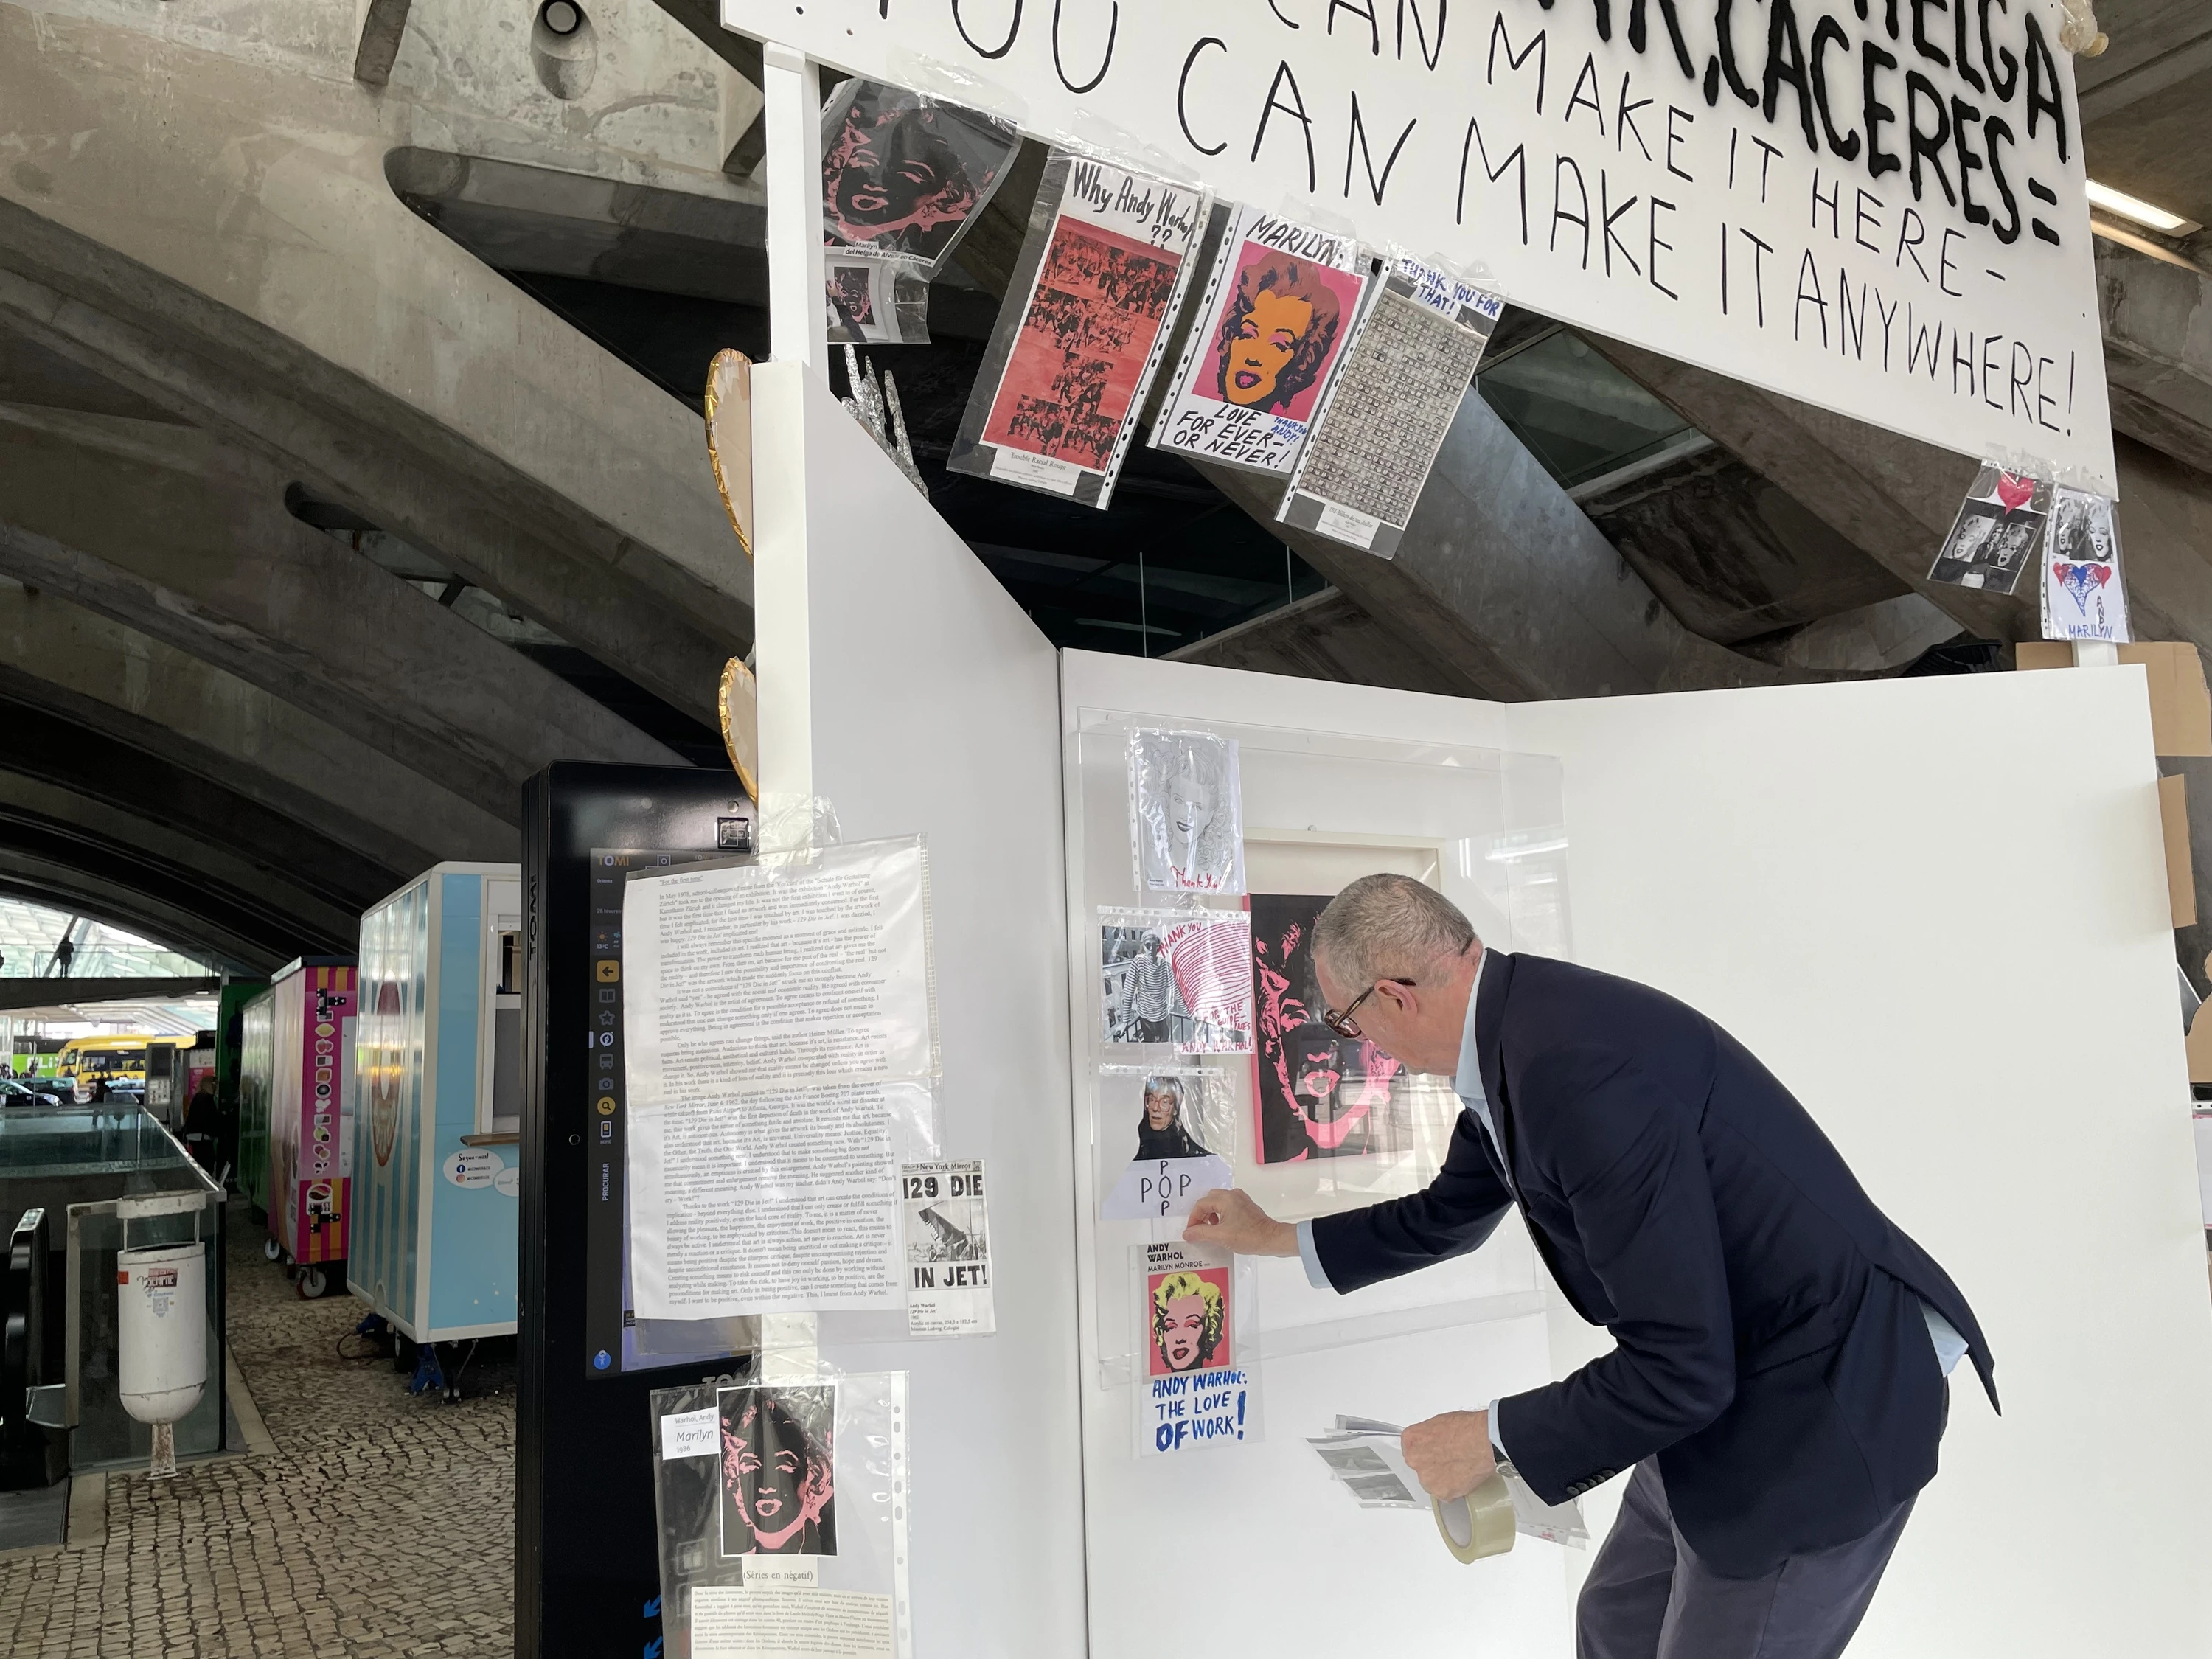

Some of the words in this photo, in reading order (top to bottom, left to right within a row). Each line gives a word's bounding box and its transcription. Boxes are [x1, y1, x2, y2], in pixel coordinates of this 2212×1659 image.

[1487, 11, 1694, 183] MAKE
[1728, 127, 1784, 204] IT
[1073, 161, 1113, 213] Why
[1114, 176, 1155, 223] Andy
[855, 241, 877, 250] Marilyn
[1178, 36, 1416, 206] CAN
[1456, 116, 1679, 302] MAKE
[1722, 222, 1774, 328] IT
[1795, 248, 2075, 437] ANYWHERE!
[1402, 259, 1447, 291] THANK
[1454, 282, 1474, 303] YOU
[1475, 294, 1500, 316] FOR
[1419, 285, 1455, 315] THAT!
[1177, 410, 1214, 434] FOR
[1214, 404, 1262, 426] LOVE
[1271, 425, 1300, 445] ANDY!
[1173, 429, 1200, 448] OR
[1204, 439, 1290, 468] NEVER!
[1011, 452, 1031, 462] Trouble
[1032, 457, 1048, 465] Racial
[1049, 461, 1067, 470] Rouge
[2068, 624, 2112, 639] MARILYN
[599, 855, 630, 866] TOMI
[1170, 866, 1203, 888] Thank
[1157, 925, 1186, 958] THANK
[1187, 922, 1202, 934] YOU
[1223, 1001, 1244, 1015] THE
[902, 1176, 939, 1199] 129
[950, 1175, 983, 1197] DIE
[1141, 1173, 1192, 1203] POP
[1147, 1243, 1169, 1253] ANDY
[1147, 1251, 1184, 1262] WARHOL
[914, 1267, 935, 1288] IN
[943, 1265, 987, 1287] JET!
[1148, 1263, 1173, 1272] MARILYN
[1175, 1260, 1203, 1269] MONROE
[1152, 1376, 1189, 1398] ANDY
[1192, 1370, 1248, 1391] WARHOL:
[1155, 1399, 1185, 1421] THE
[1194, 1391, 1231, 1414] LOVE
[675, 1415, 698, 1424] Warhol,
[699, 1413, 714, 1422] Andy
[676, 1429, 714, 1442] Marilyn
[1156, 1420, 1189, 1452] OF
[743, 1570, 768, 1581] (Séries
[784, 1570, 813, 1582] négatif)
